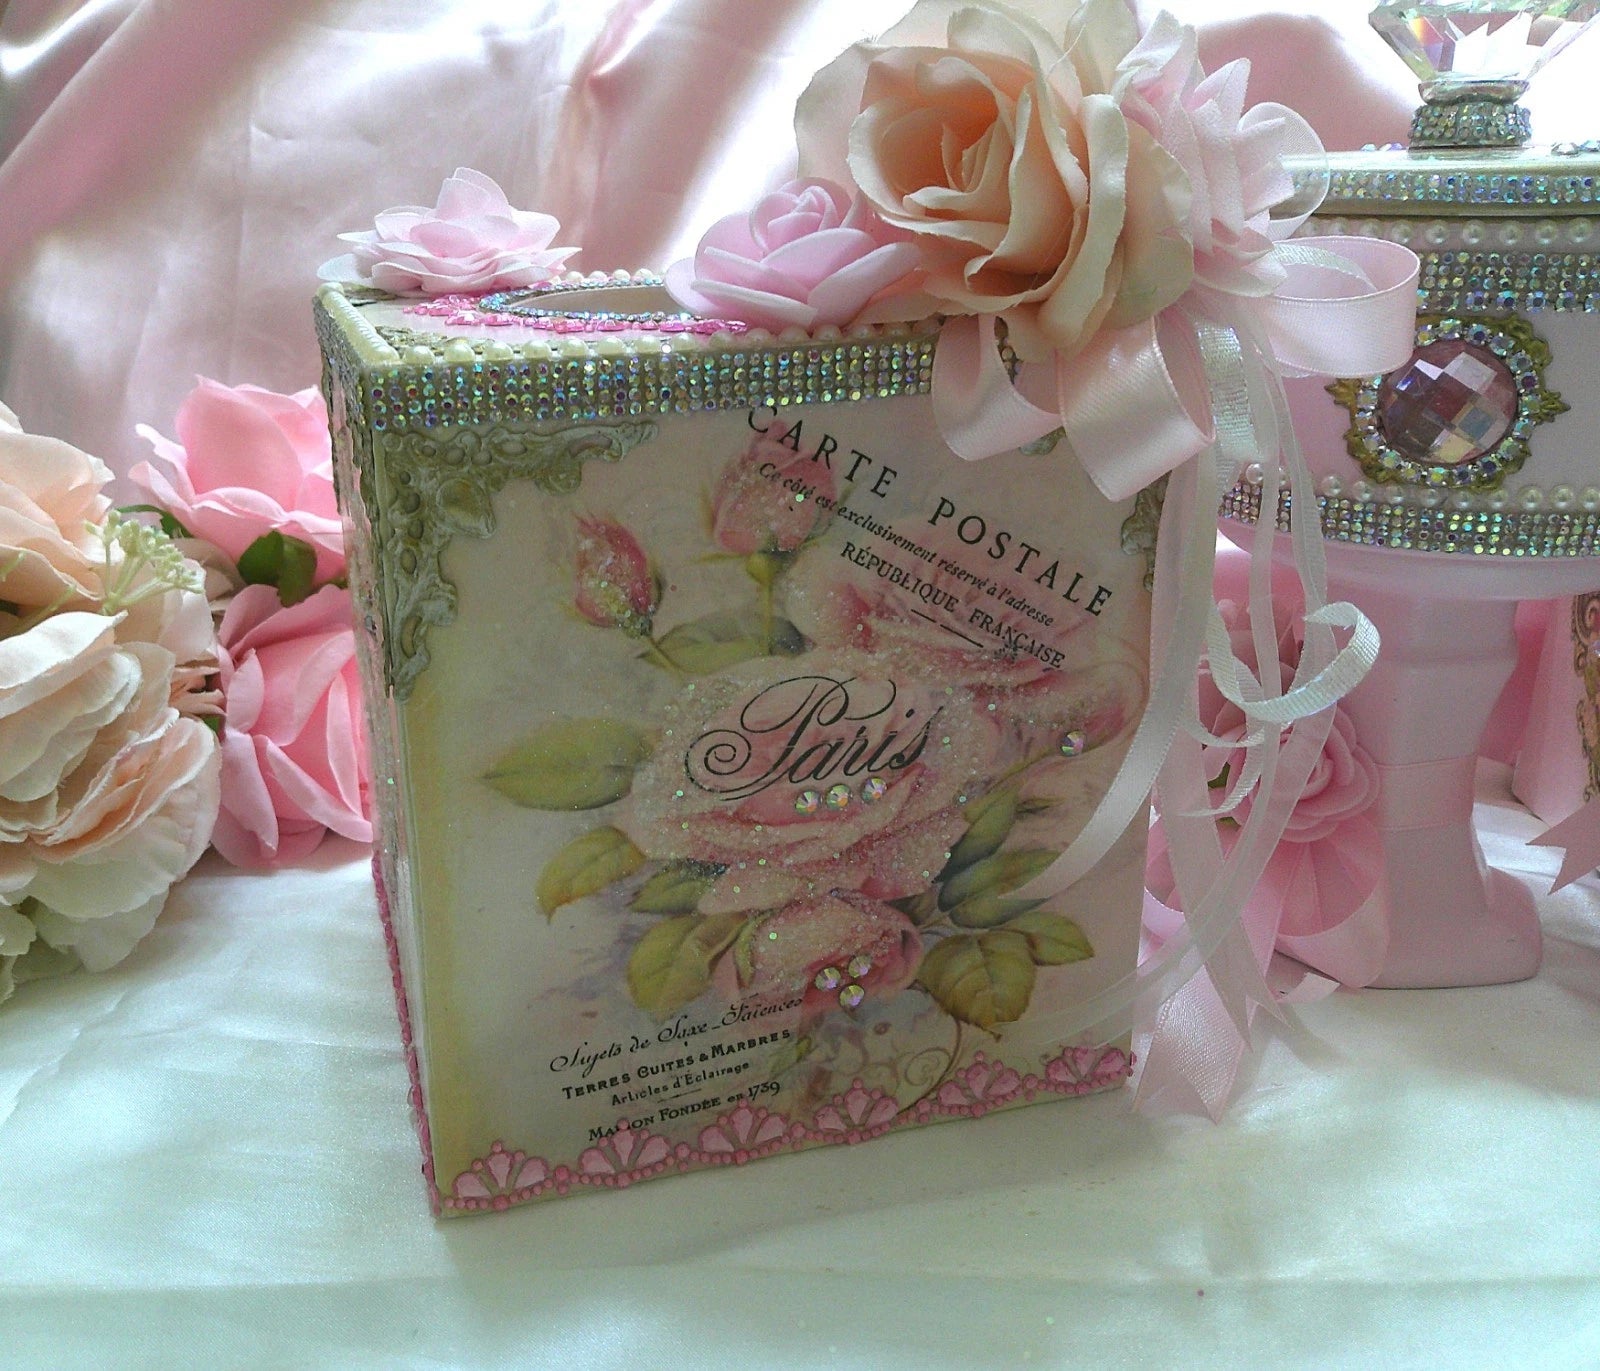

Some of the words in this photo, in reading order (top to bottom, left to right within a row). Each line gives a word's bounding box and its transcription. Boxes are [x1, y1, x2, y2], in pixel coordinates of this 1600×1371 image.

[748, 406, 898, 498] CARTE
[928, 496, 1113, 617] POSTALE
[837, 506, 938, 564] exclusivement
[937, 556, 989, 589] réservé
[997, 587, 1055, 627] l'adresse
[840, 541, 959, 613] RÉPUBLIQUE
[968, 607, 1066, 668] FRANÇAISE
[684, 675, 943, 802] Paris
[549, 1041, 622, 1078] Sujets
[629, 1035, 651, 1053] de
[562, 1072, 632, 1100] TERRES
[636, 1054, 694, 1080] CUITES
[699, 1051, 709, 1063] &
[711, 1028, 792, 1060] MARBRES
[611, 1084, 669, 1106] Articles
[747, 1080, 781, 1102] 1739
